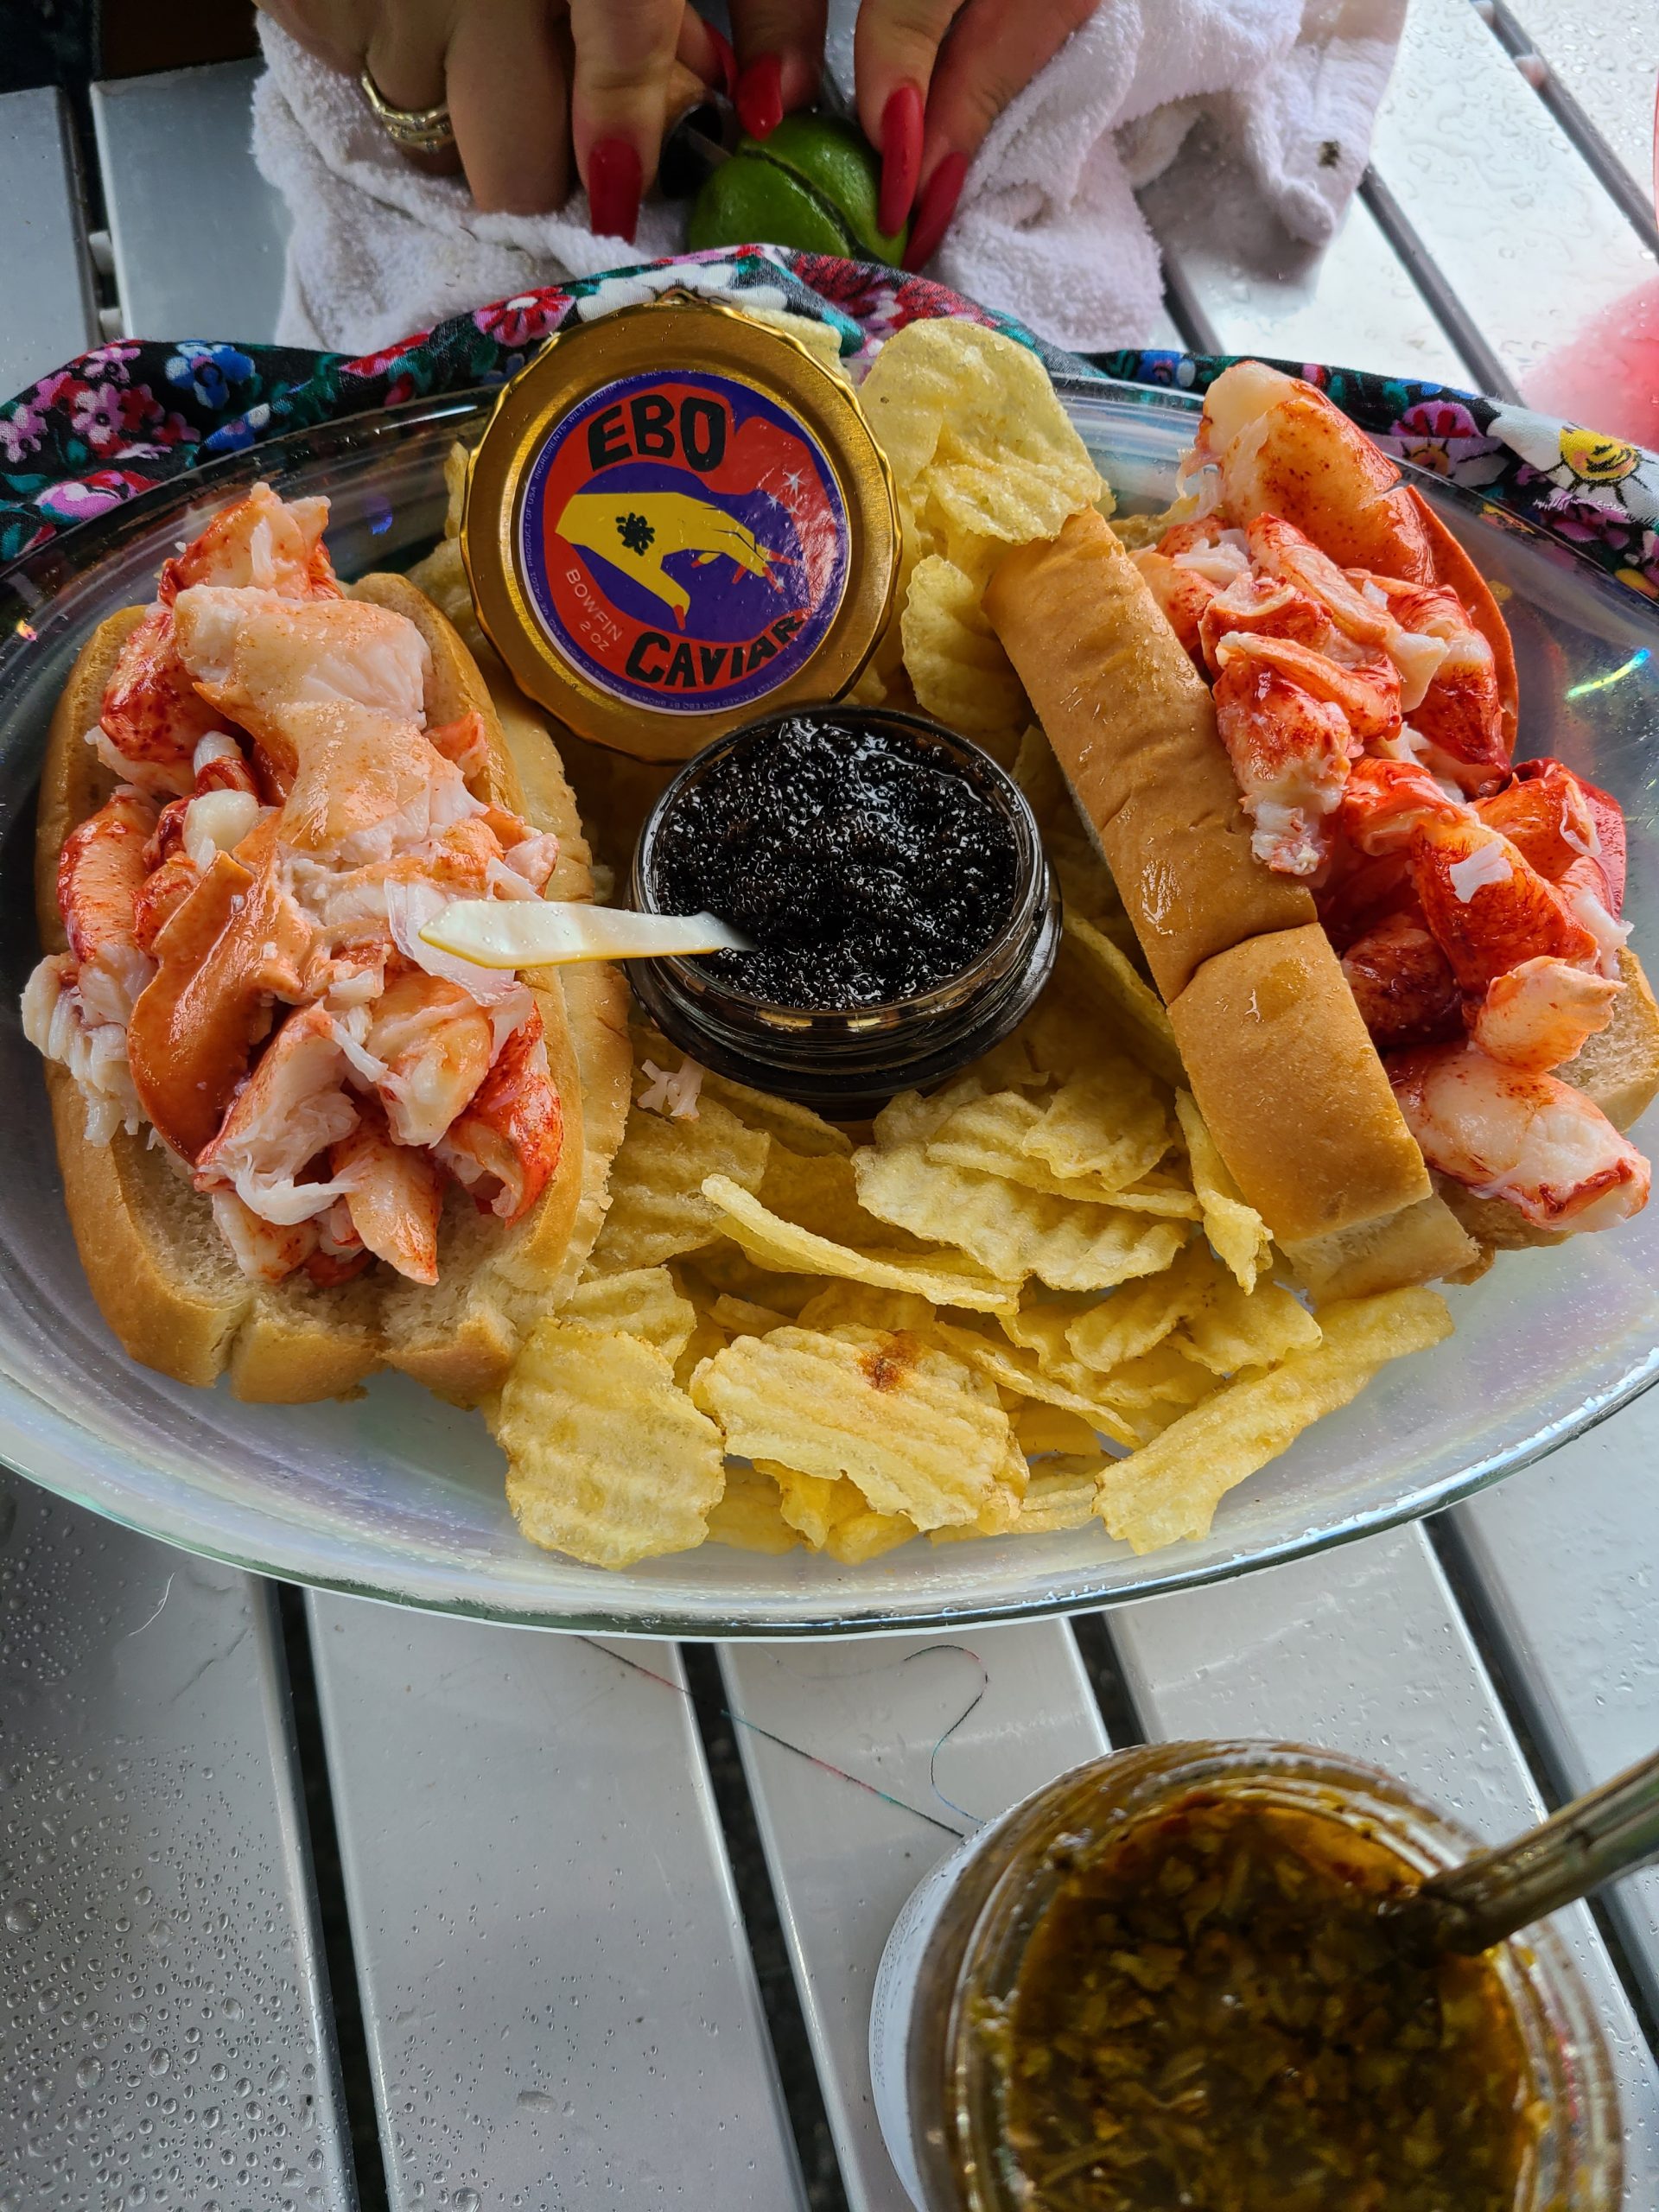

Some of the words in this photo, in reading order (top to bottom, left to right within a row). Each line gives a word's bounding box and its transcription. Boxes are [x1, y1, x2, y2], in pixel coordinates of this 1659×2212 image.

[567, 404, 585, 423] WILD
[588, 395, 727, 472] EBO
[527, 486, 536, 505] USA
[525, 507, 531, 520] OF
[566, 569, 622, 641] BOWFIN
[580, 620, 591, 632] 2
[590, 632, 609, 652] OZ
[626, 615, 804, 688] CAVIAR
[722, 692, 755, 705] PACKED
